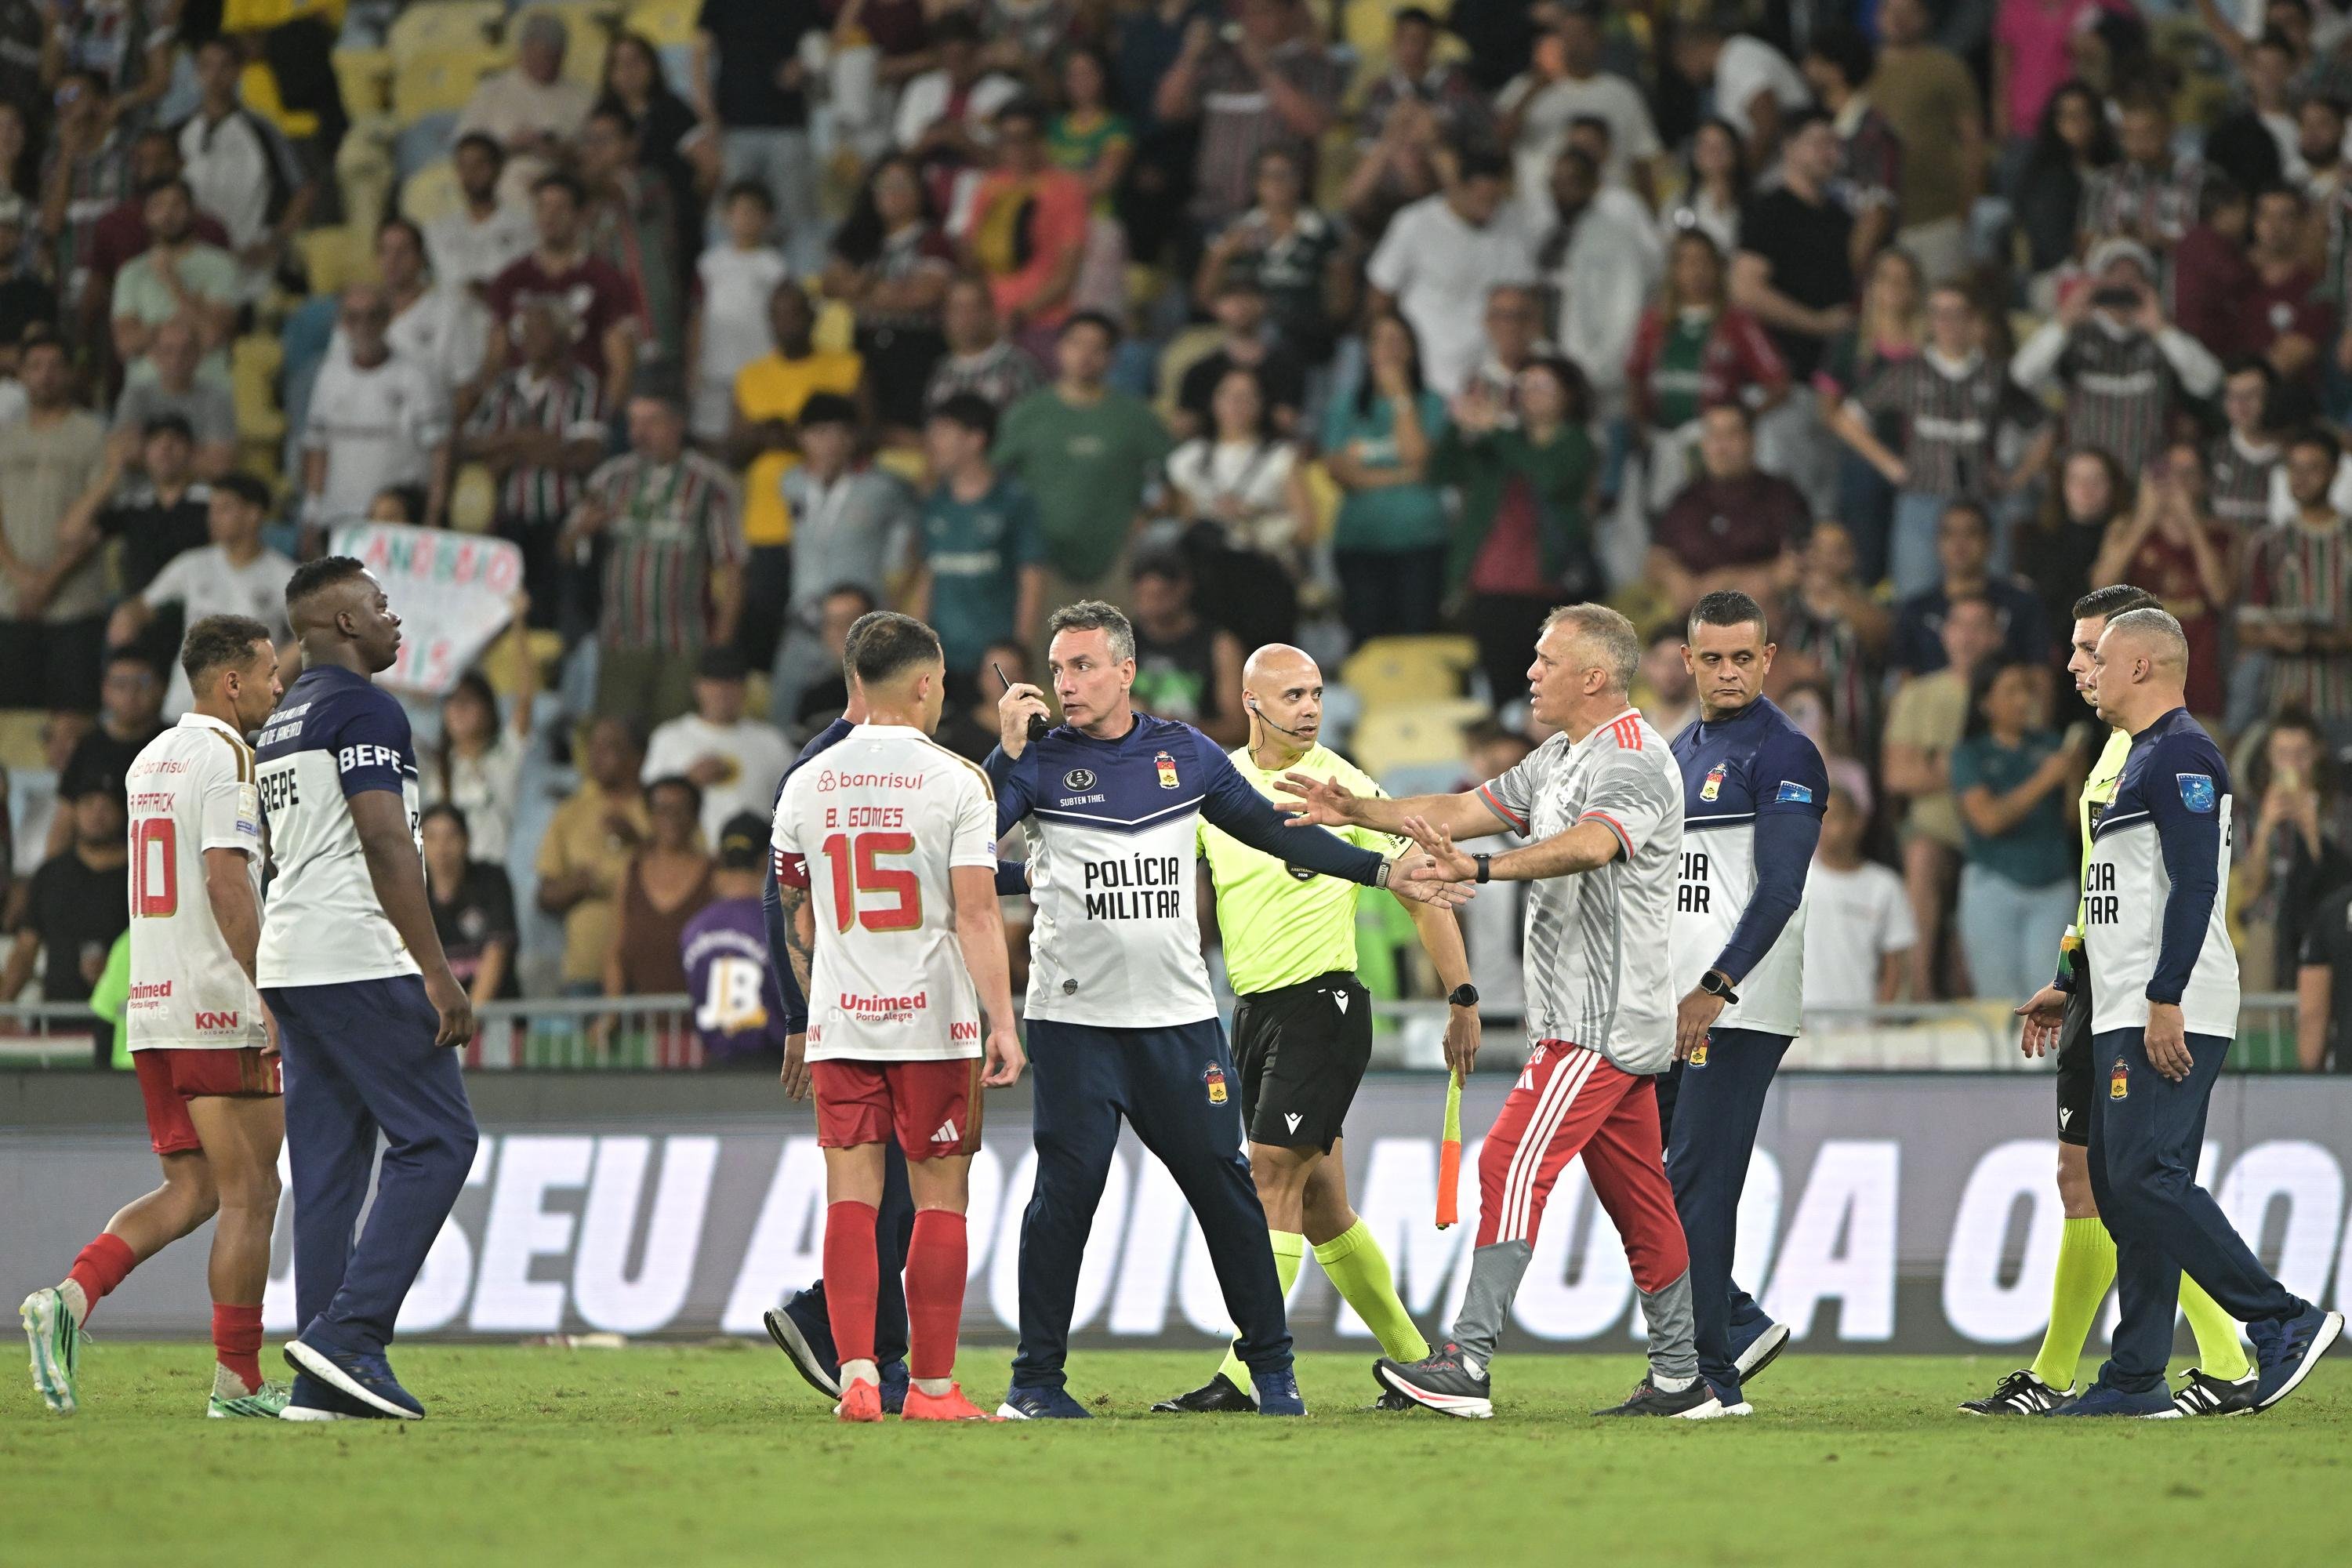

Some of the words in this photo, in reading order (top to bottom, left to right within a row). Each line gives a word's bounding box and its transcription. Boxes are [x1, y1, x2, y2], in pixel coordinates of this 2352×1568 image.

[339, 744, 402, 775] BEPE
[840, 771, 923, 789] banrisul
[260, 768, 299, 813] BEPE
[1060, 796, 1087, 807] SUBTEN
[1087, 794, 1105, 804] THIEL
[137, 793, 175, 813] PATRICK
[826, 808, 840, 828] B.
[848, 807, 903, 827] GOMES
[130, 818, 177, 918] 10
[1084, 852, 1179, 889] POLÍCIA
[822, 832, 923, 935] 15
[1085, 891, 1180, 920] MILITAR
[840, 991, 927, 1011] Unimed
[195, 1011, 238, 1029] KNN
[856, 1012, 880, 1022] Porto
[884, 1011, 913, 1022] Alegre
[950, 1022, 978, 1040] KNN
